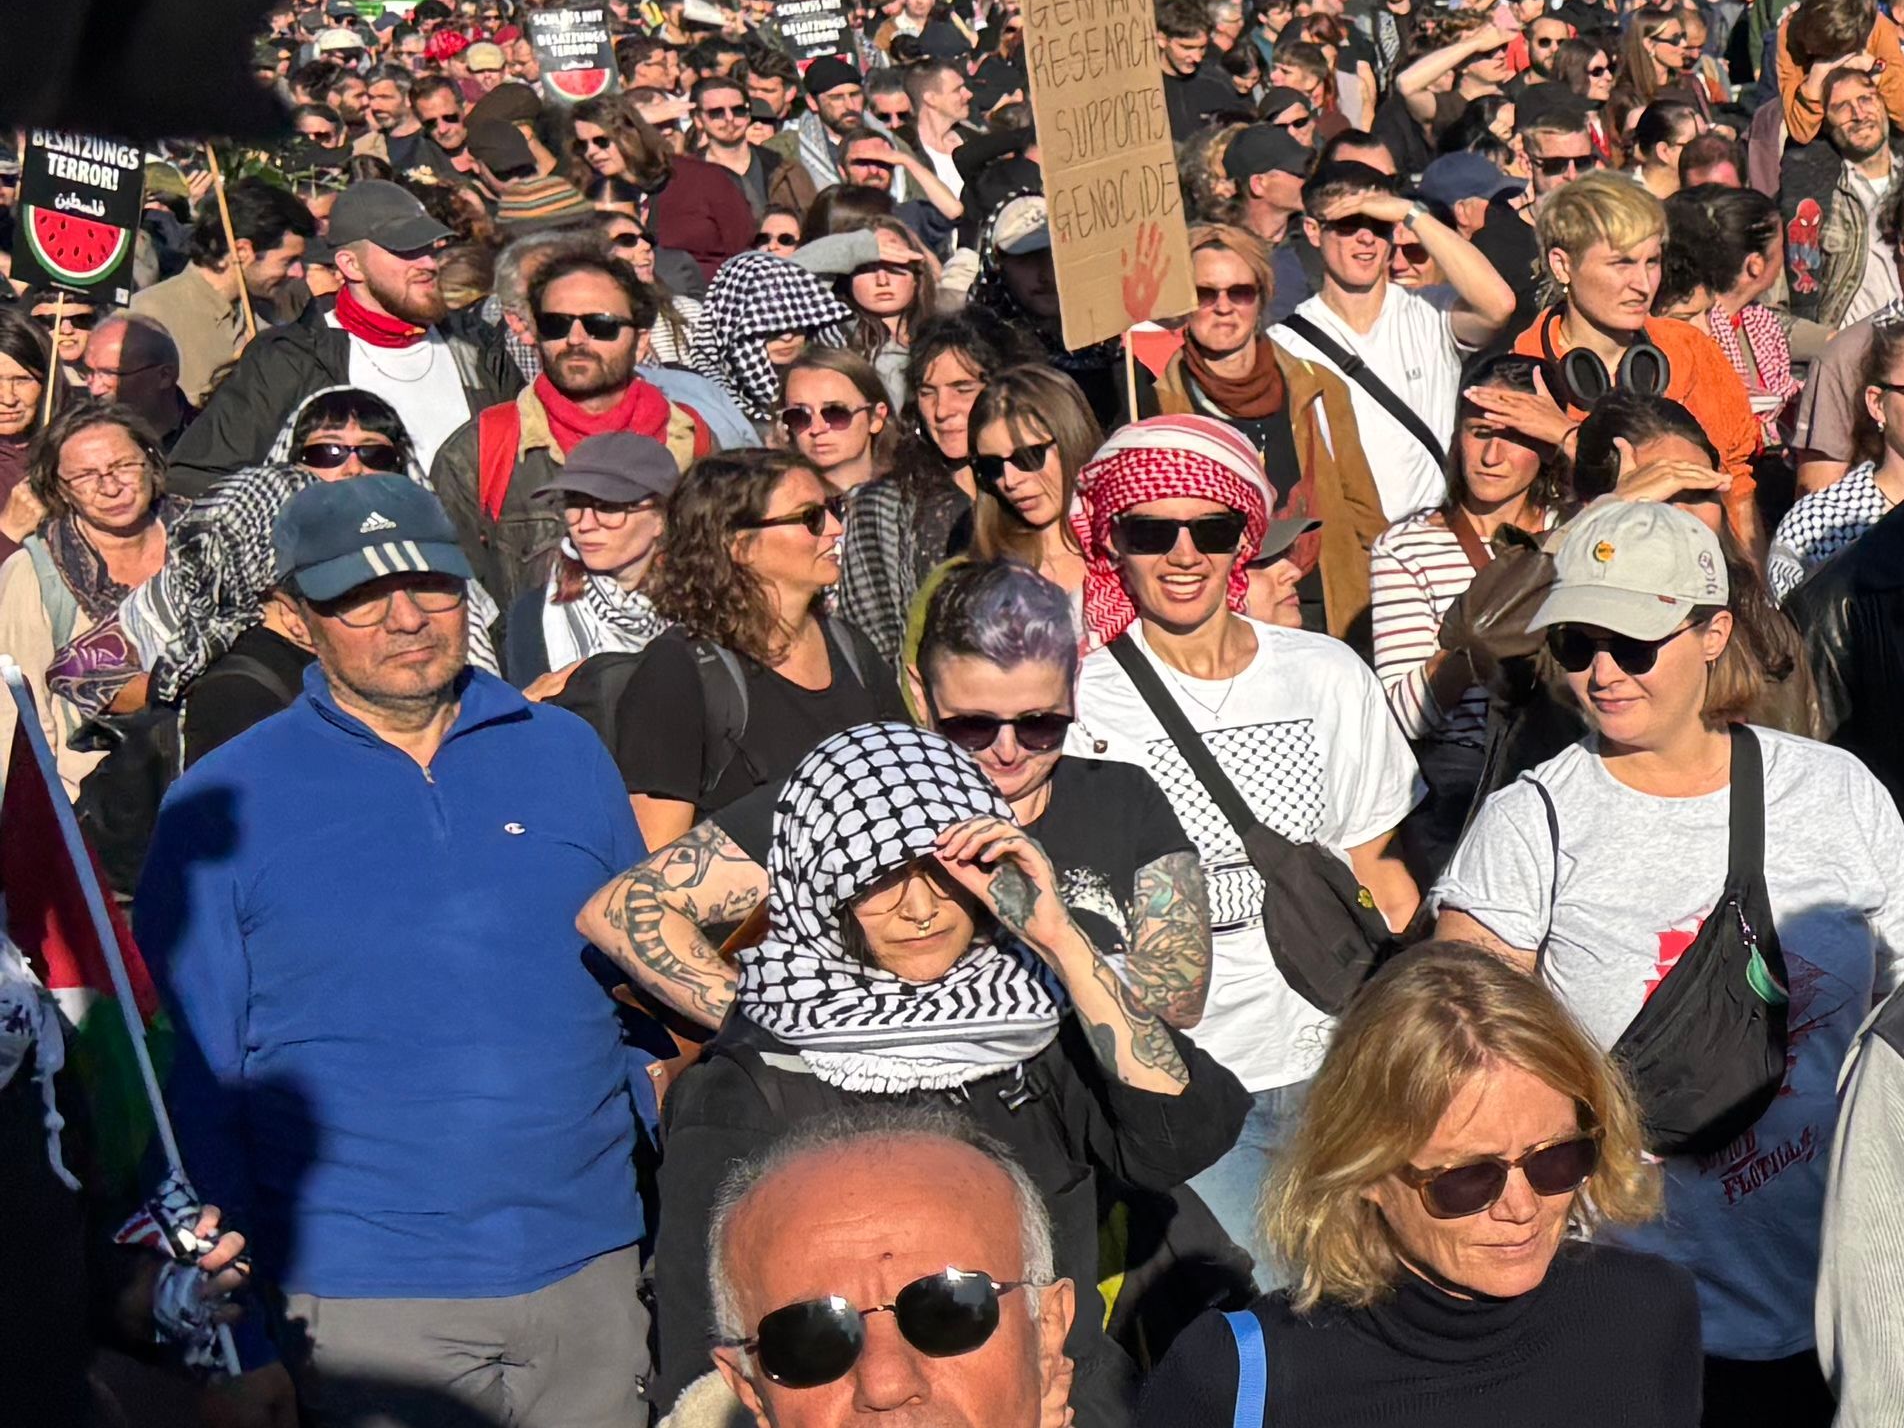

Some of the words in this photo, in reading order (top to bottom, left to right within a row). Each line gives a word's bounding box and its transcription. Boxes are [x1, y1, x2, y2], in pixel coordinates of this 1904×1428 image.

[1029, 17, 1158, 90] RESEARCH
[32, 127, 139, 170] BESATZUNGS
[1056, 87, 1168, 165] SUPPORTS
[47, 152, 119, 192] TERROR!
[1052, 161, 1181, 240] GENOCIDE
[54, 192, 105, 217] فلسطين
